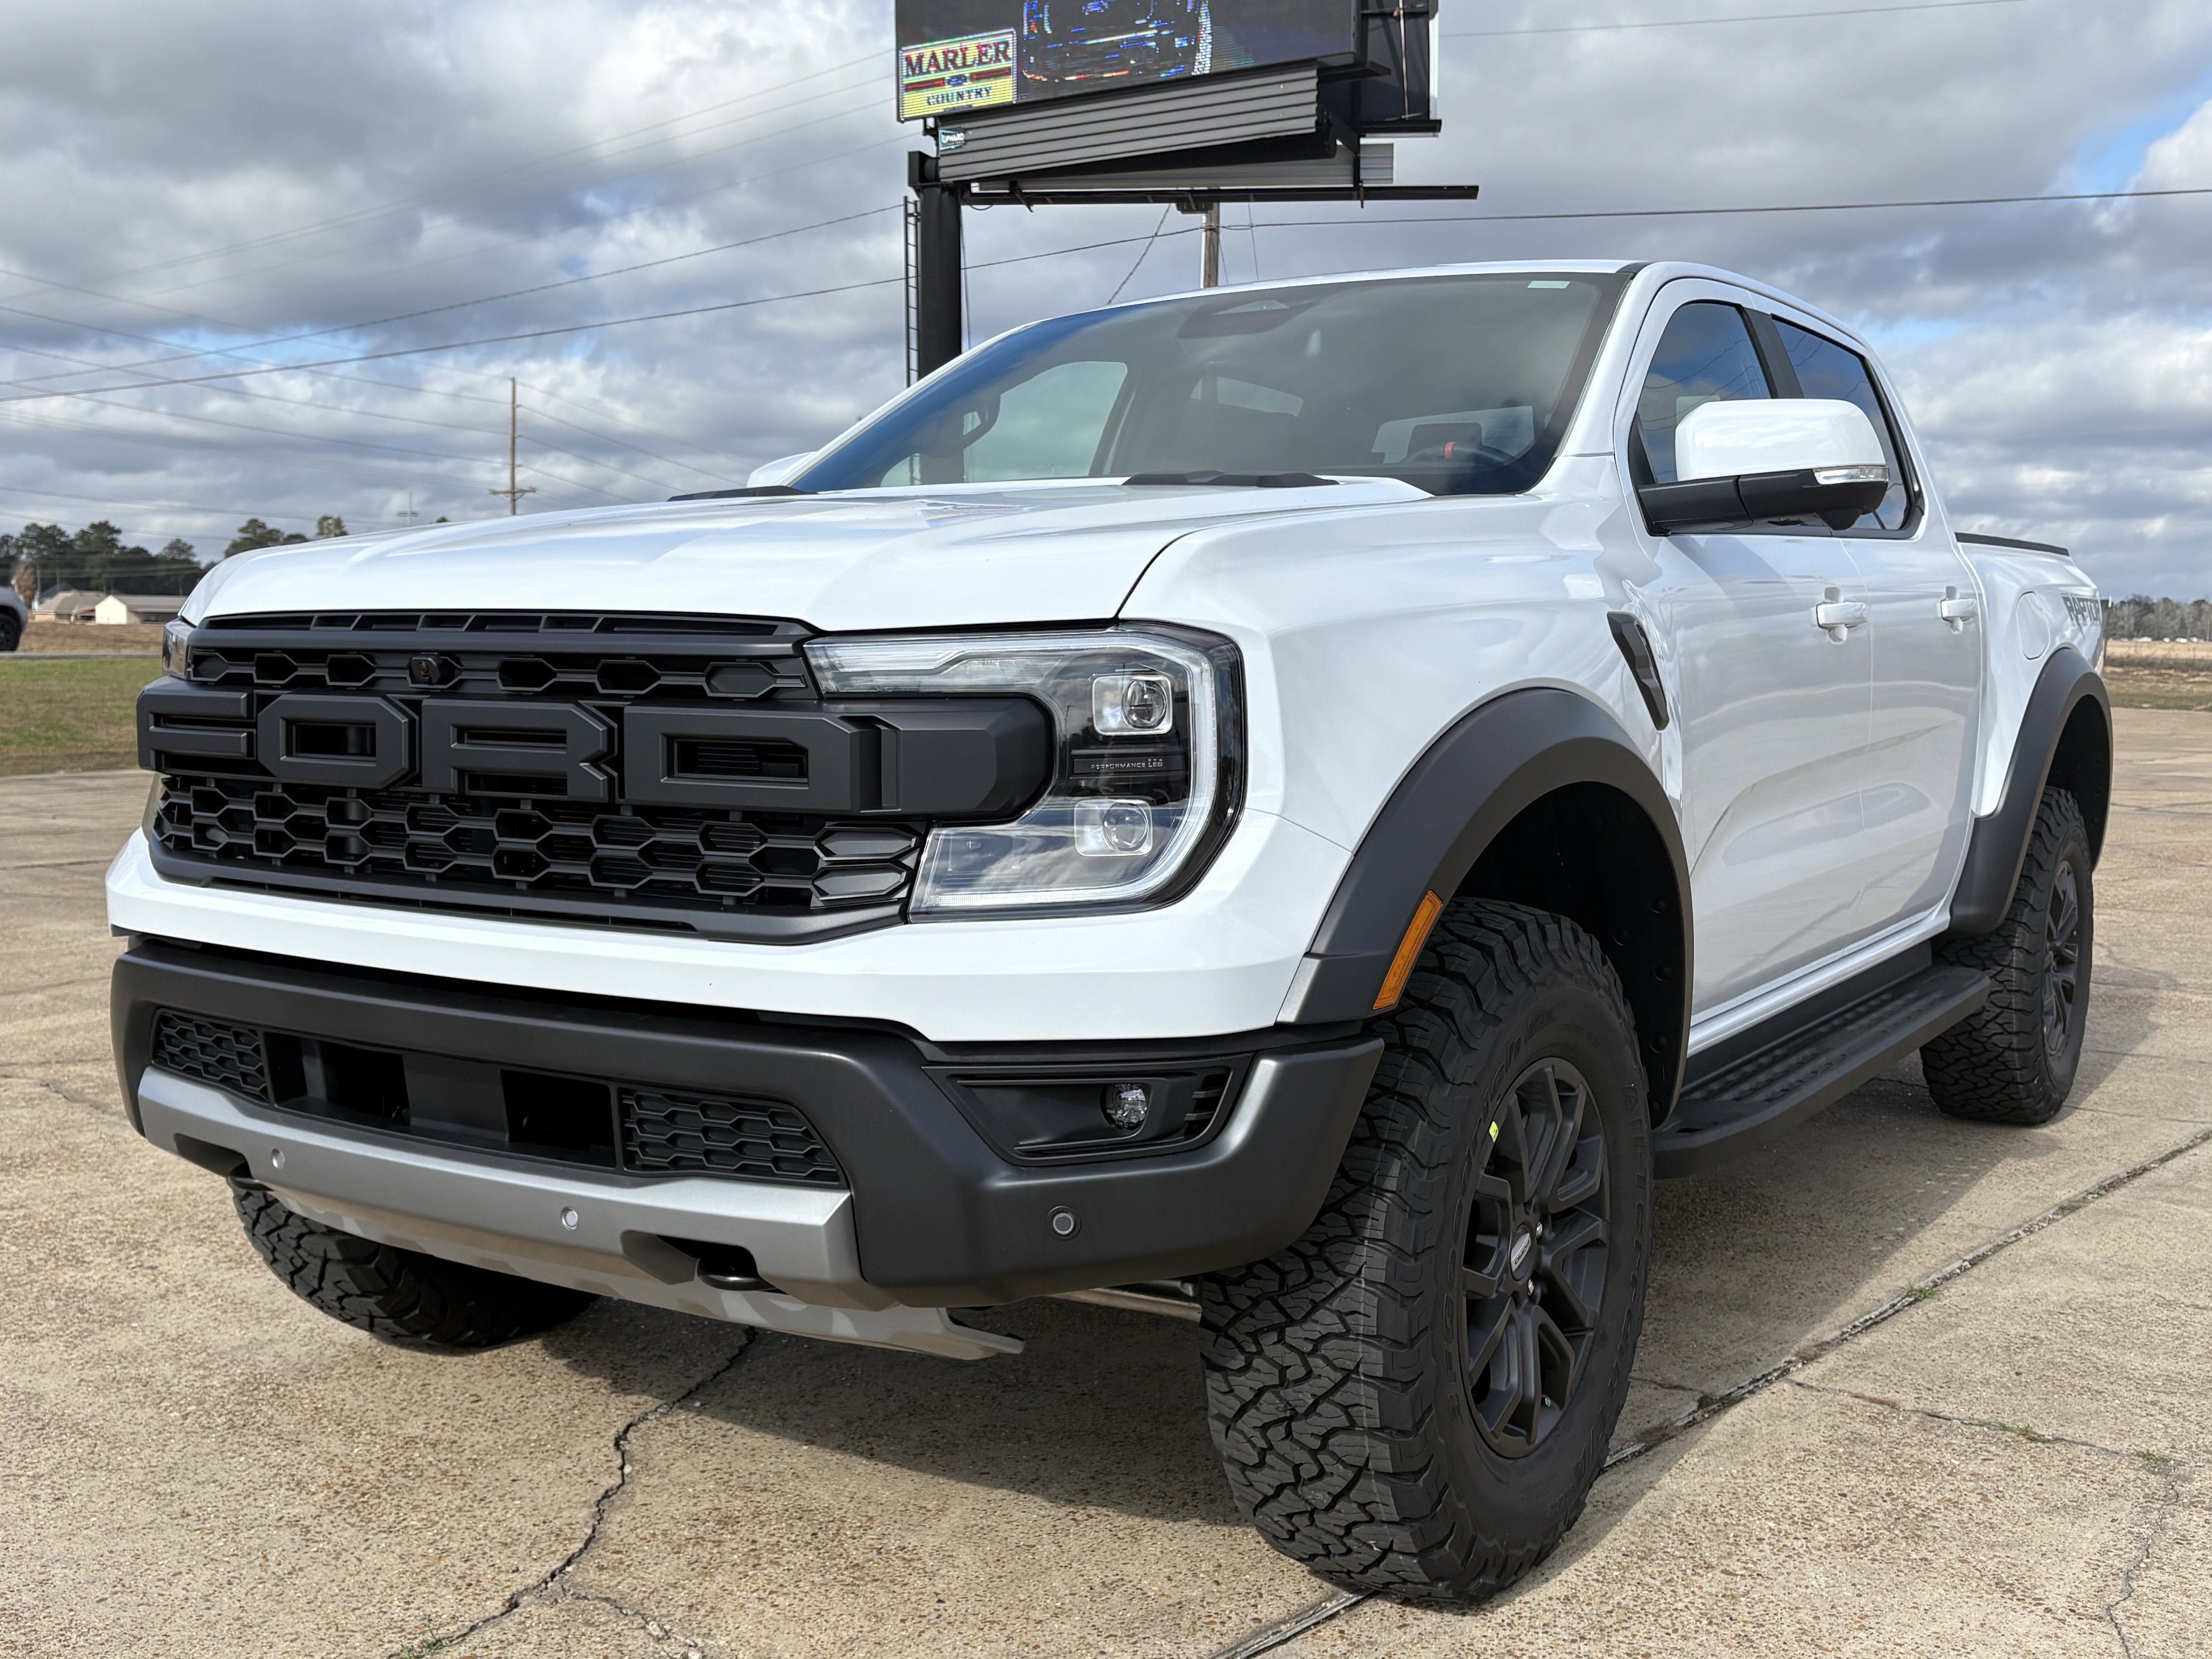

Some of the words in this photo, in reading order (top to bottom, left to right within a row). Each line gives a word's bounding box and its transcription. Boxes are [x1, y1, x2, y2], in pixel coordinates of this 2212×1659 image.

[905, 41, 1012, 76] MARLER
[927, 86, 993, 106] COUNTRY
[136, 680, 863, 812] FORD
